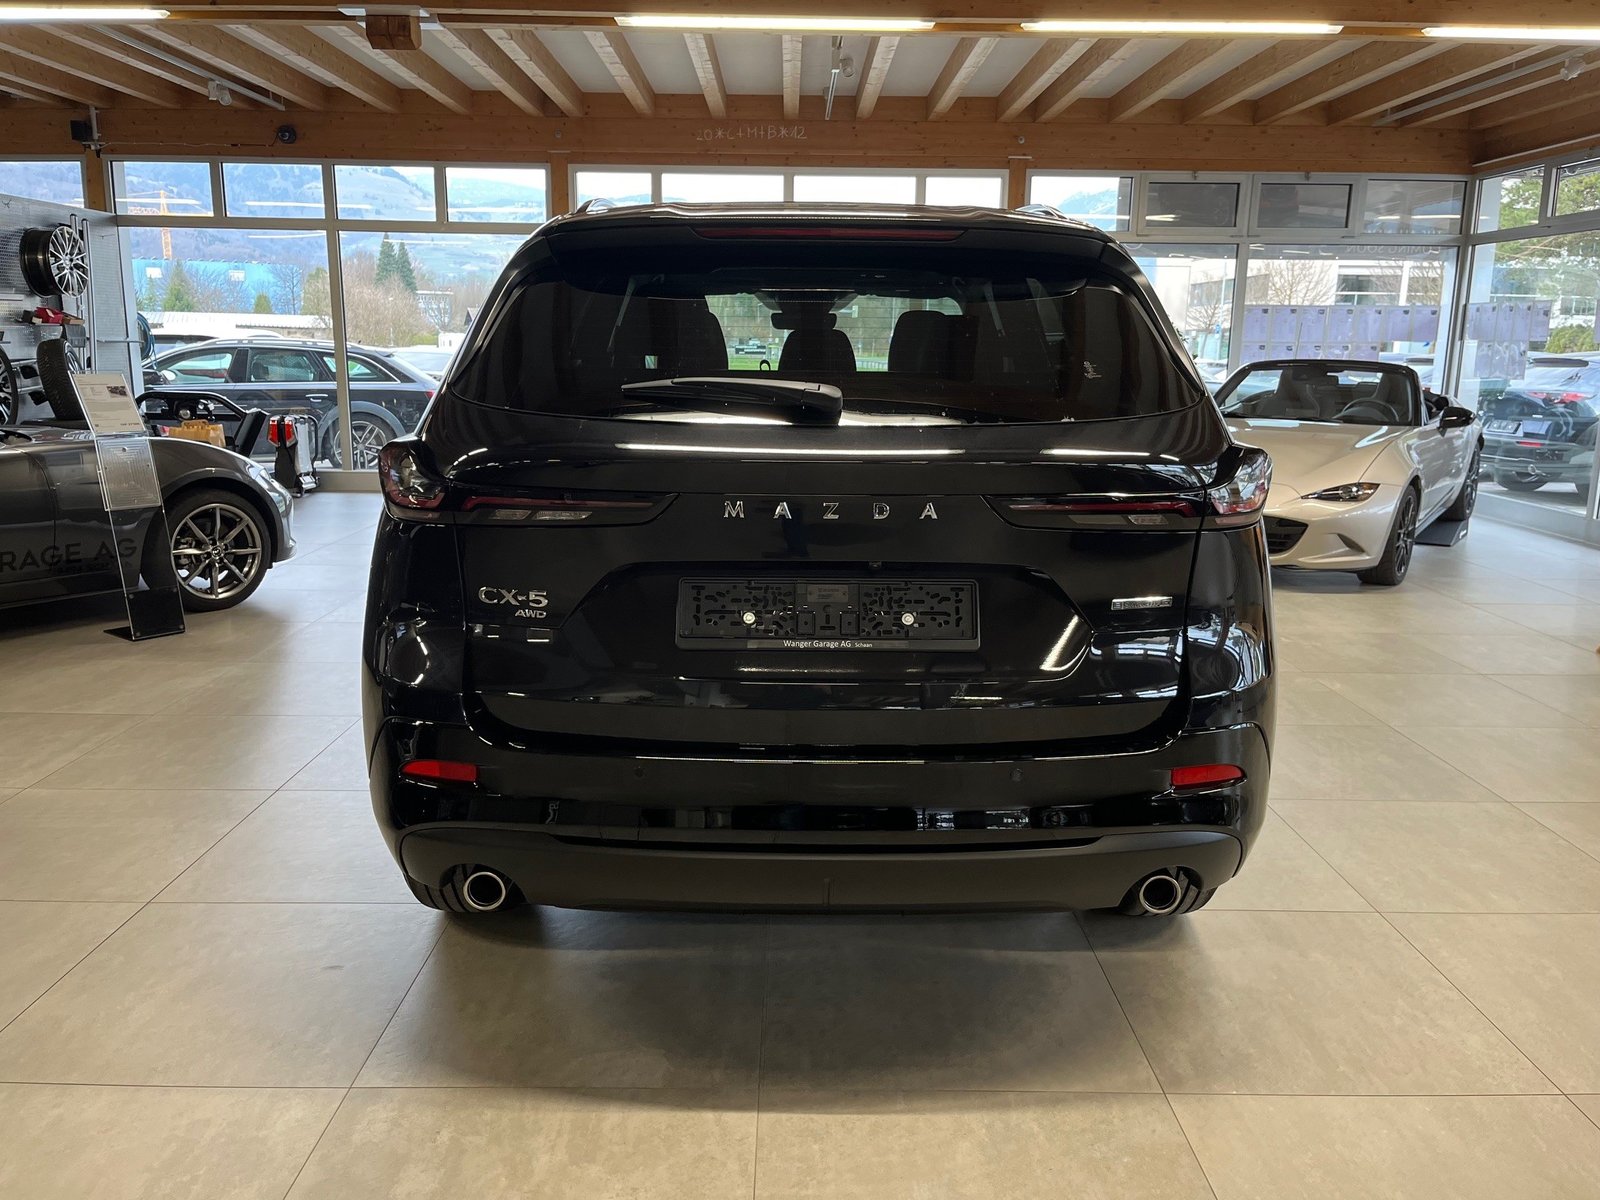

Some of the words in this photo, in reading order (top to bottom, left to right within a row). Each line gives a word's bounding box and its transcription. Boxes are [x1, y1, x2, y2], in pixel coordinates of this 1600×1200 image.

[723, 500, 939, 520] MAZDA
[95, 538, 137, 561] AG
[478, 586, 549, 608] CX-5
[514, 609, 547, 619] AWD
[783, 640, 812, 649] Wanger
[813, 640, 839, 649] Garage
[840, 640, 852, 648] AG
